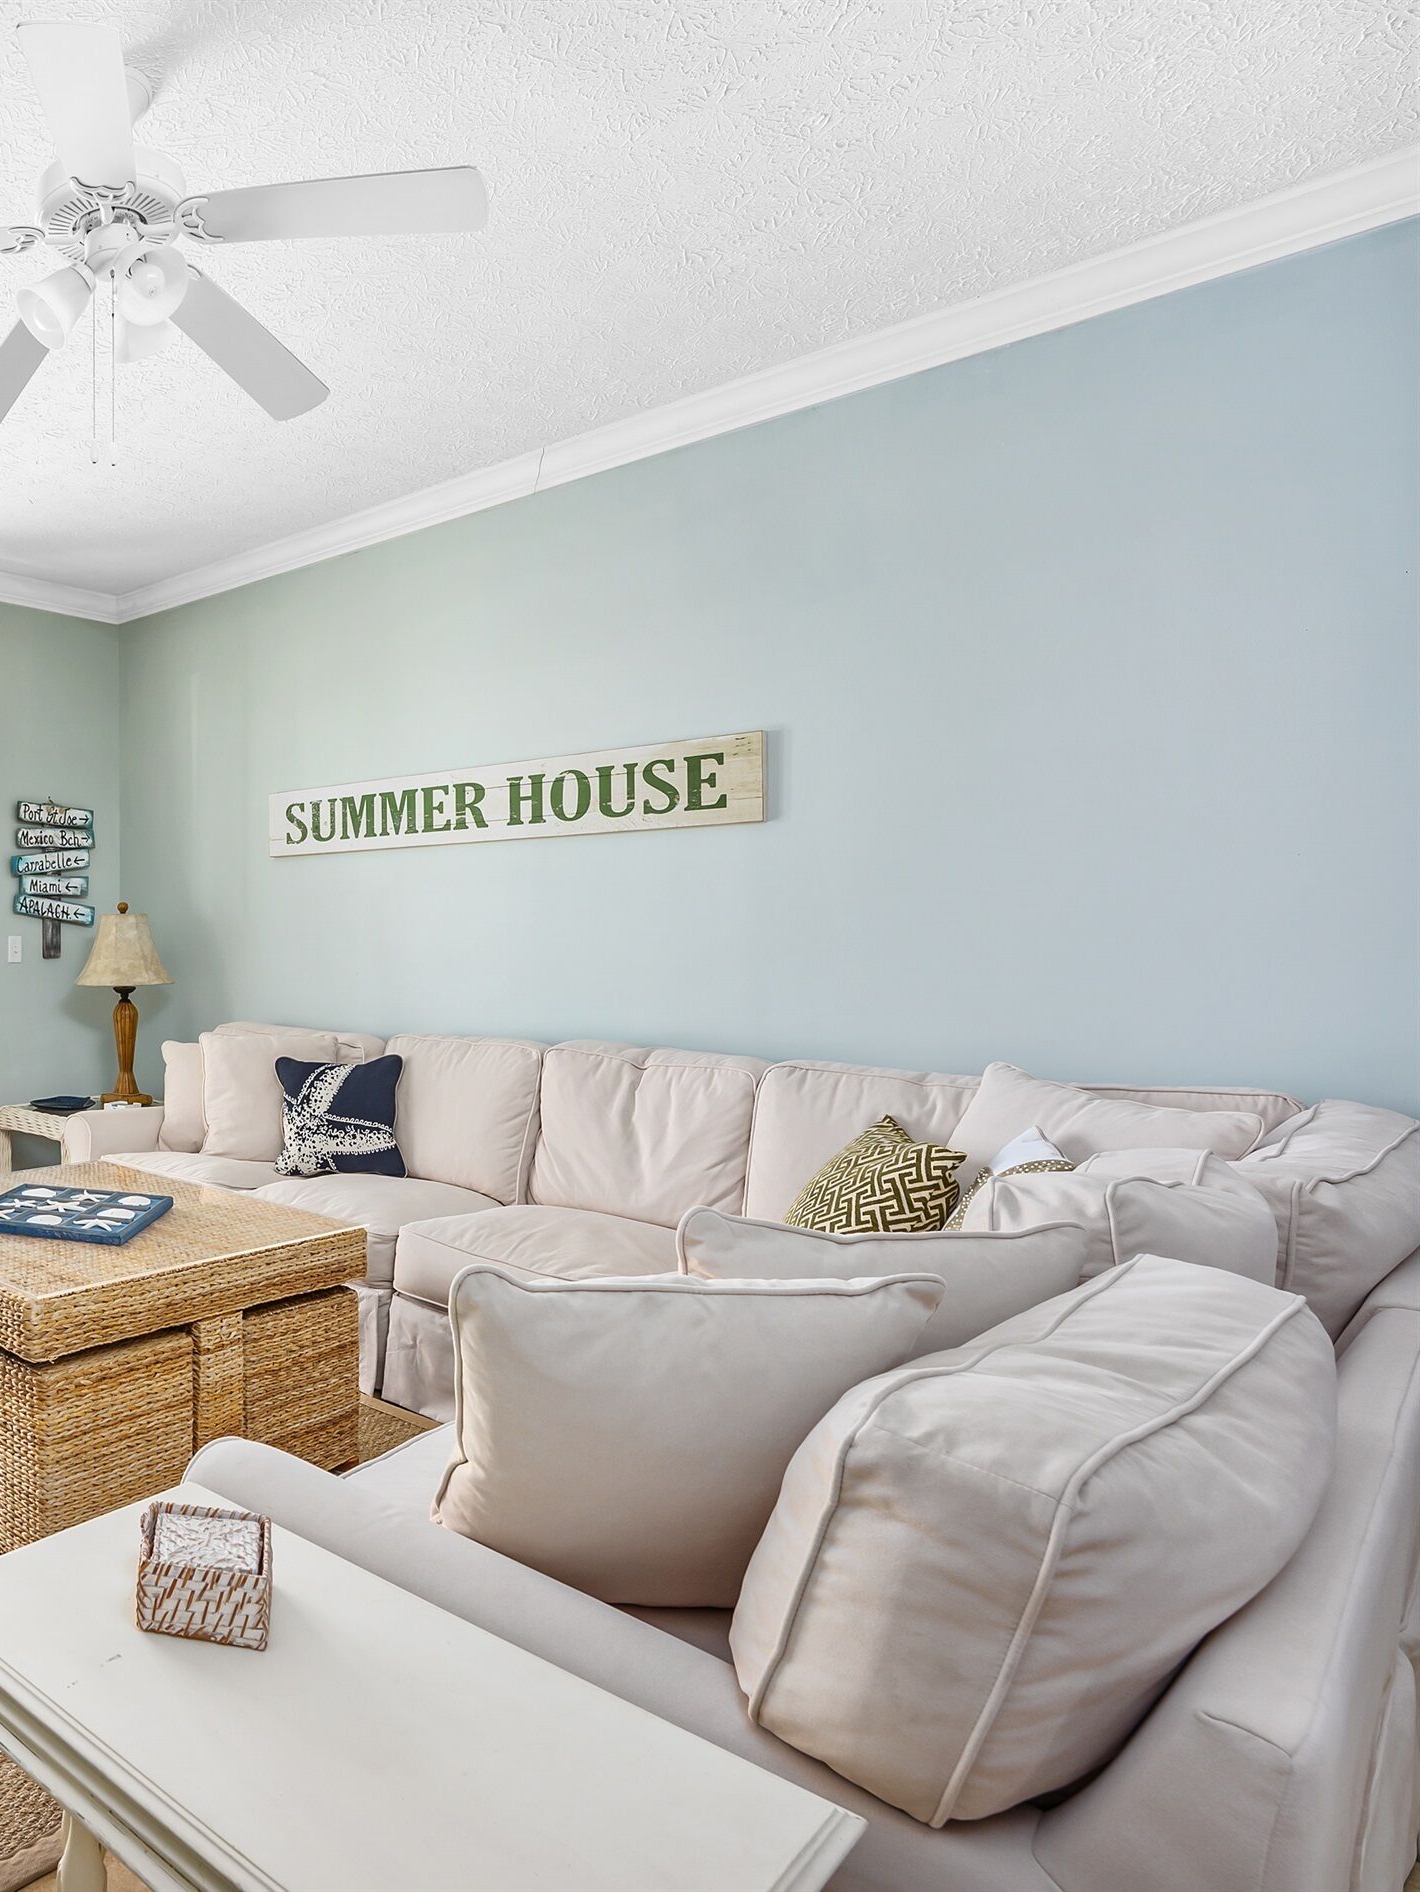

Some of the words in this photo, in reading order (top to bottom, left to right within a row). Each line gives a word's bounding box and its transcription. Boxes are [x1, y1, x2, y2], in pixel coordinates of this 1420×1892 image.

[284, 781, 489, 845] SUMMER
[506, 752, 728, 826] HOUSE
[23, 803, 43, 822] Port
[59, 807, 77, 826] Joe
[20, 829, 54, 847] Mexico
[59, 829, 82, 847] Bch.
[17, 853, 73, 874] Carrabelle
[29, 879, 62, 893] Miami
